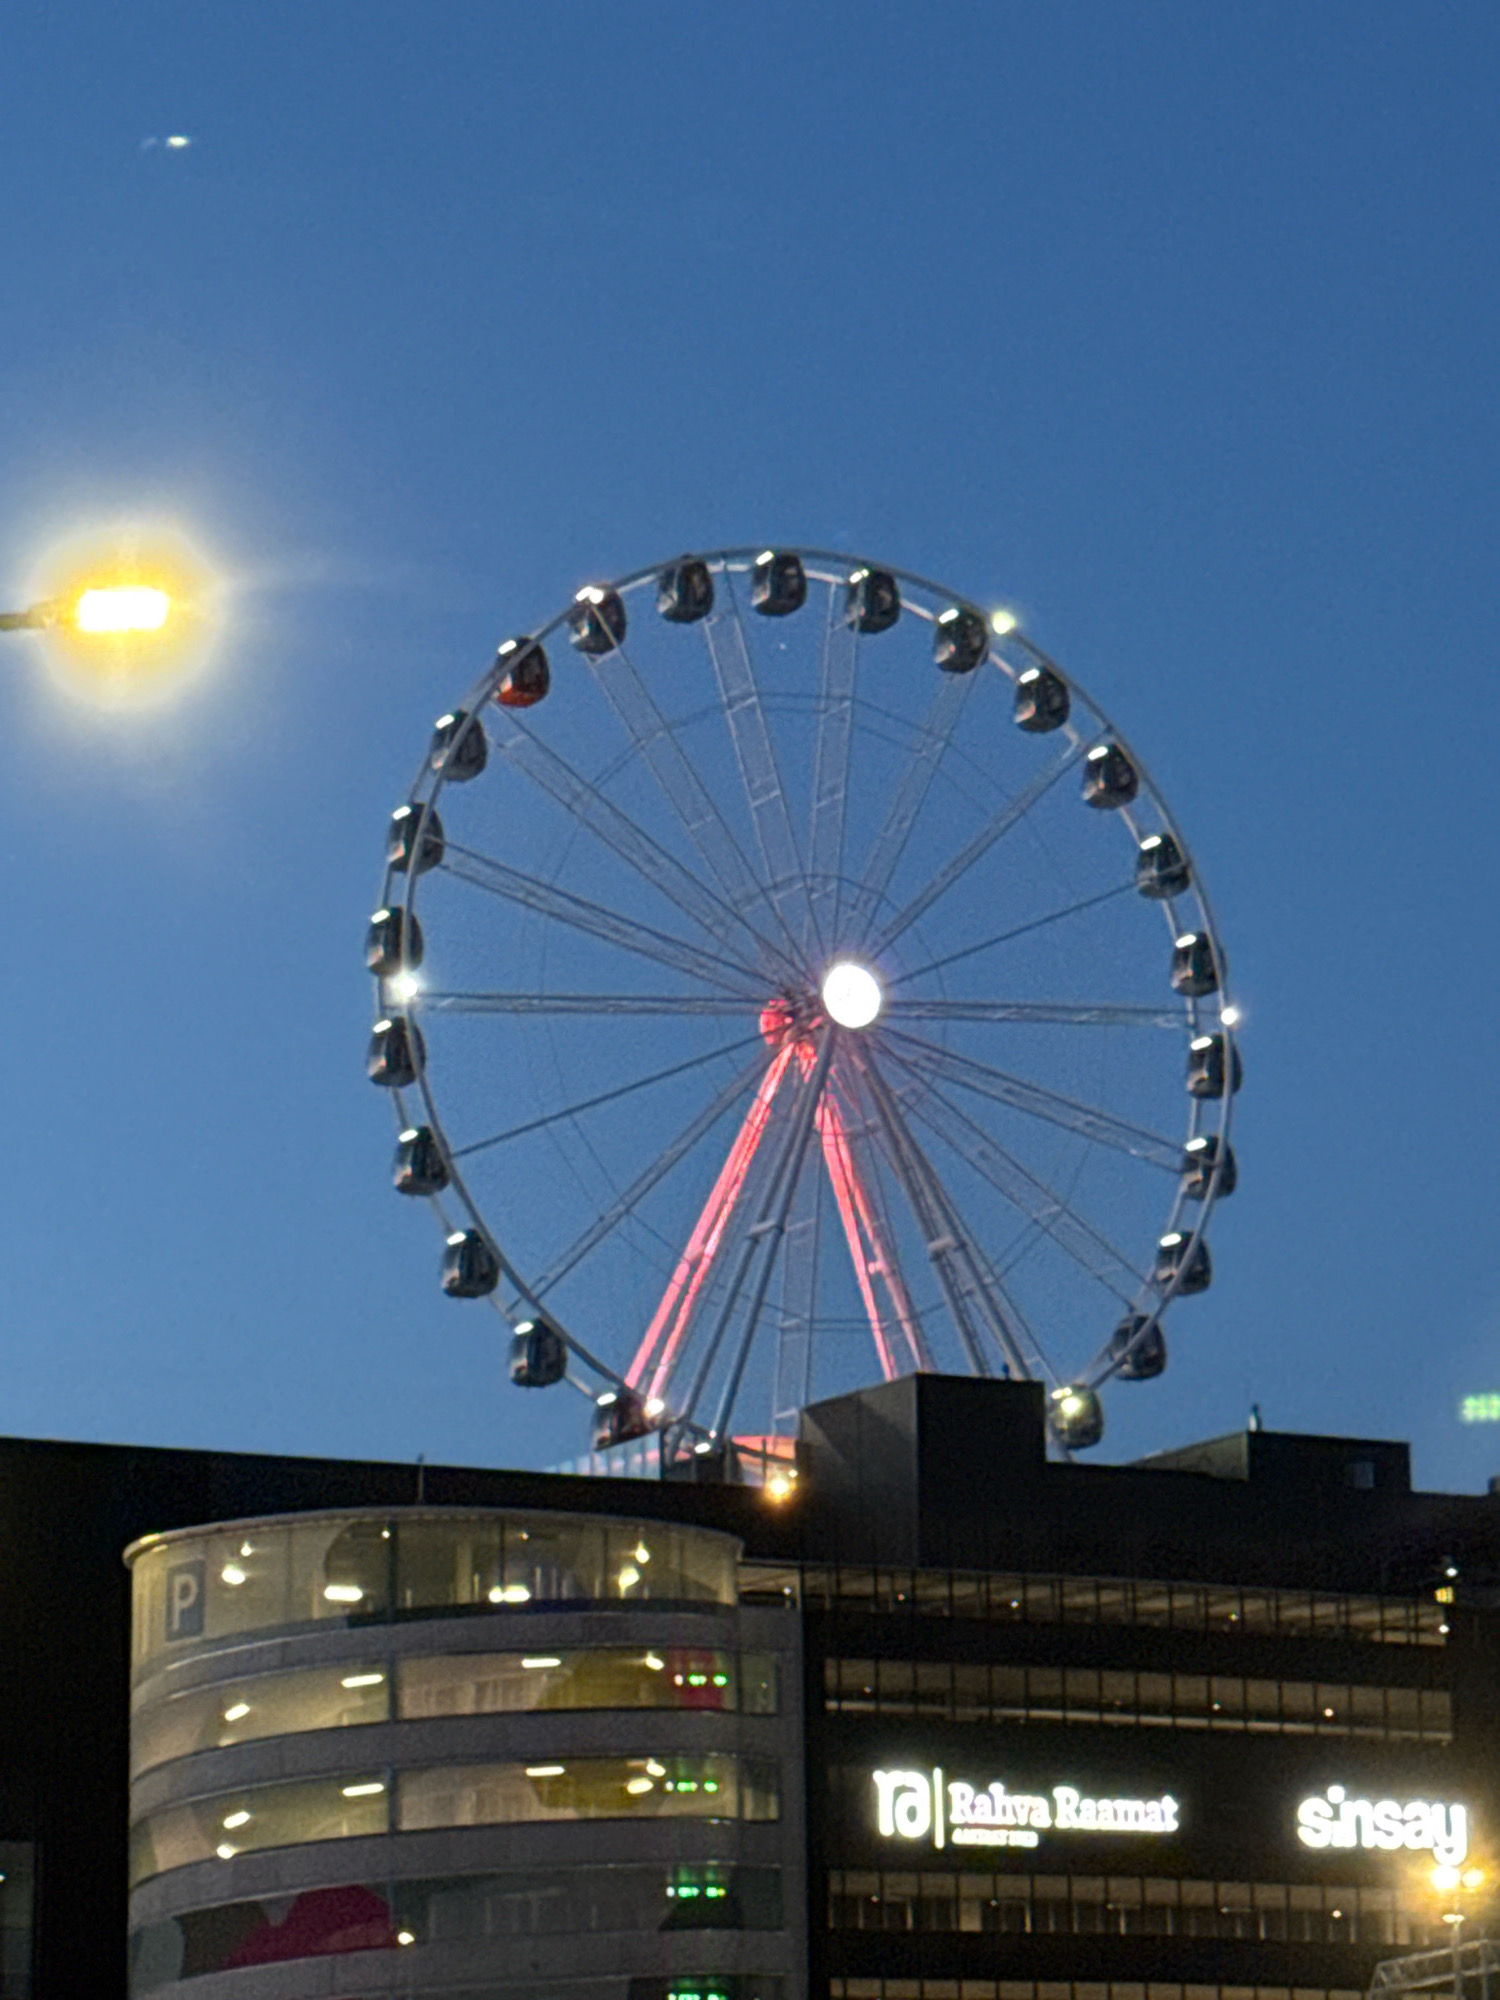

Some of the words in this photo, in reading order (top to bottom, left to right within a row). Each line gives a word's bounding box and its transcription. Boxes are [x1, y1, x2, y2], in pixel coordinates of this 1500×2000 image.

[172, 1573, 198, 1631] P
[948, 1782, 1052, 1828] Rahva
[1053, 1786, 1179, 1832] Raamat
[1297, 1785, 1467, 1867] sinsay
